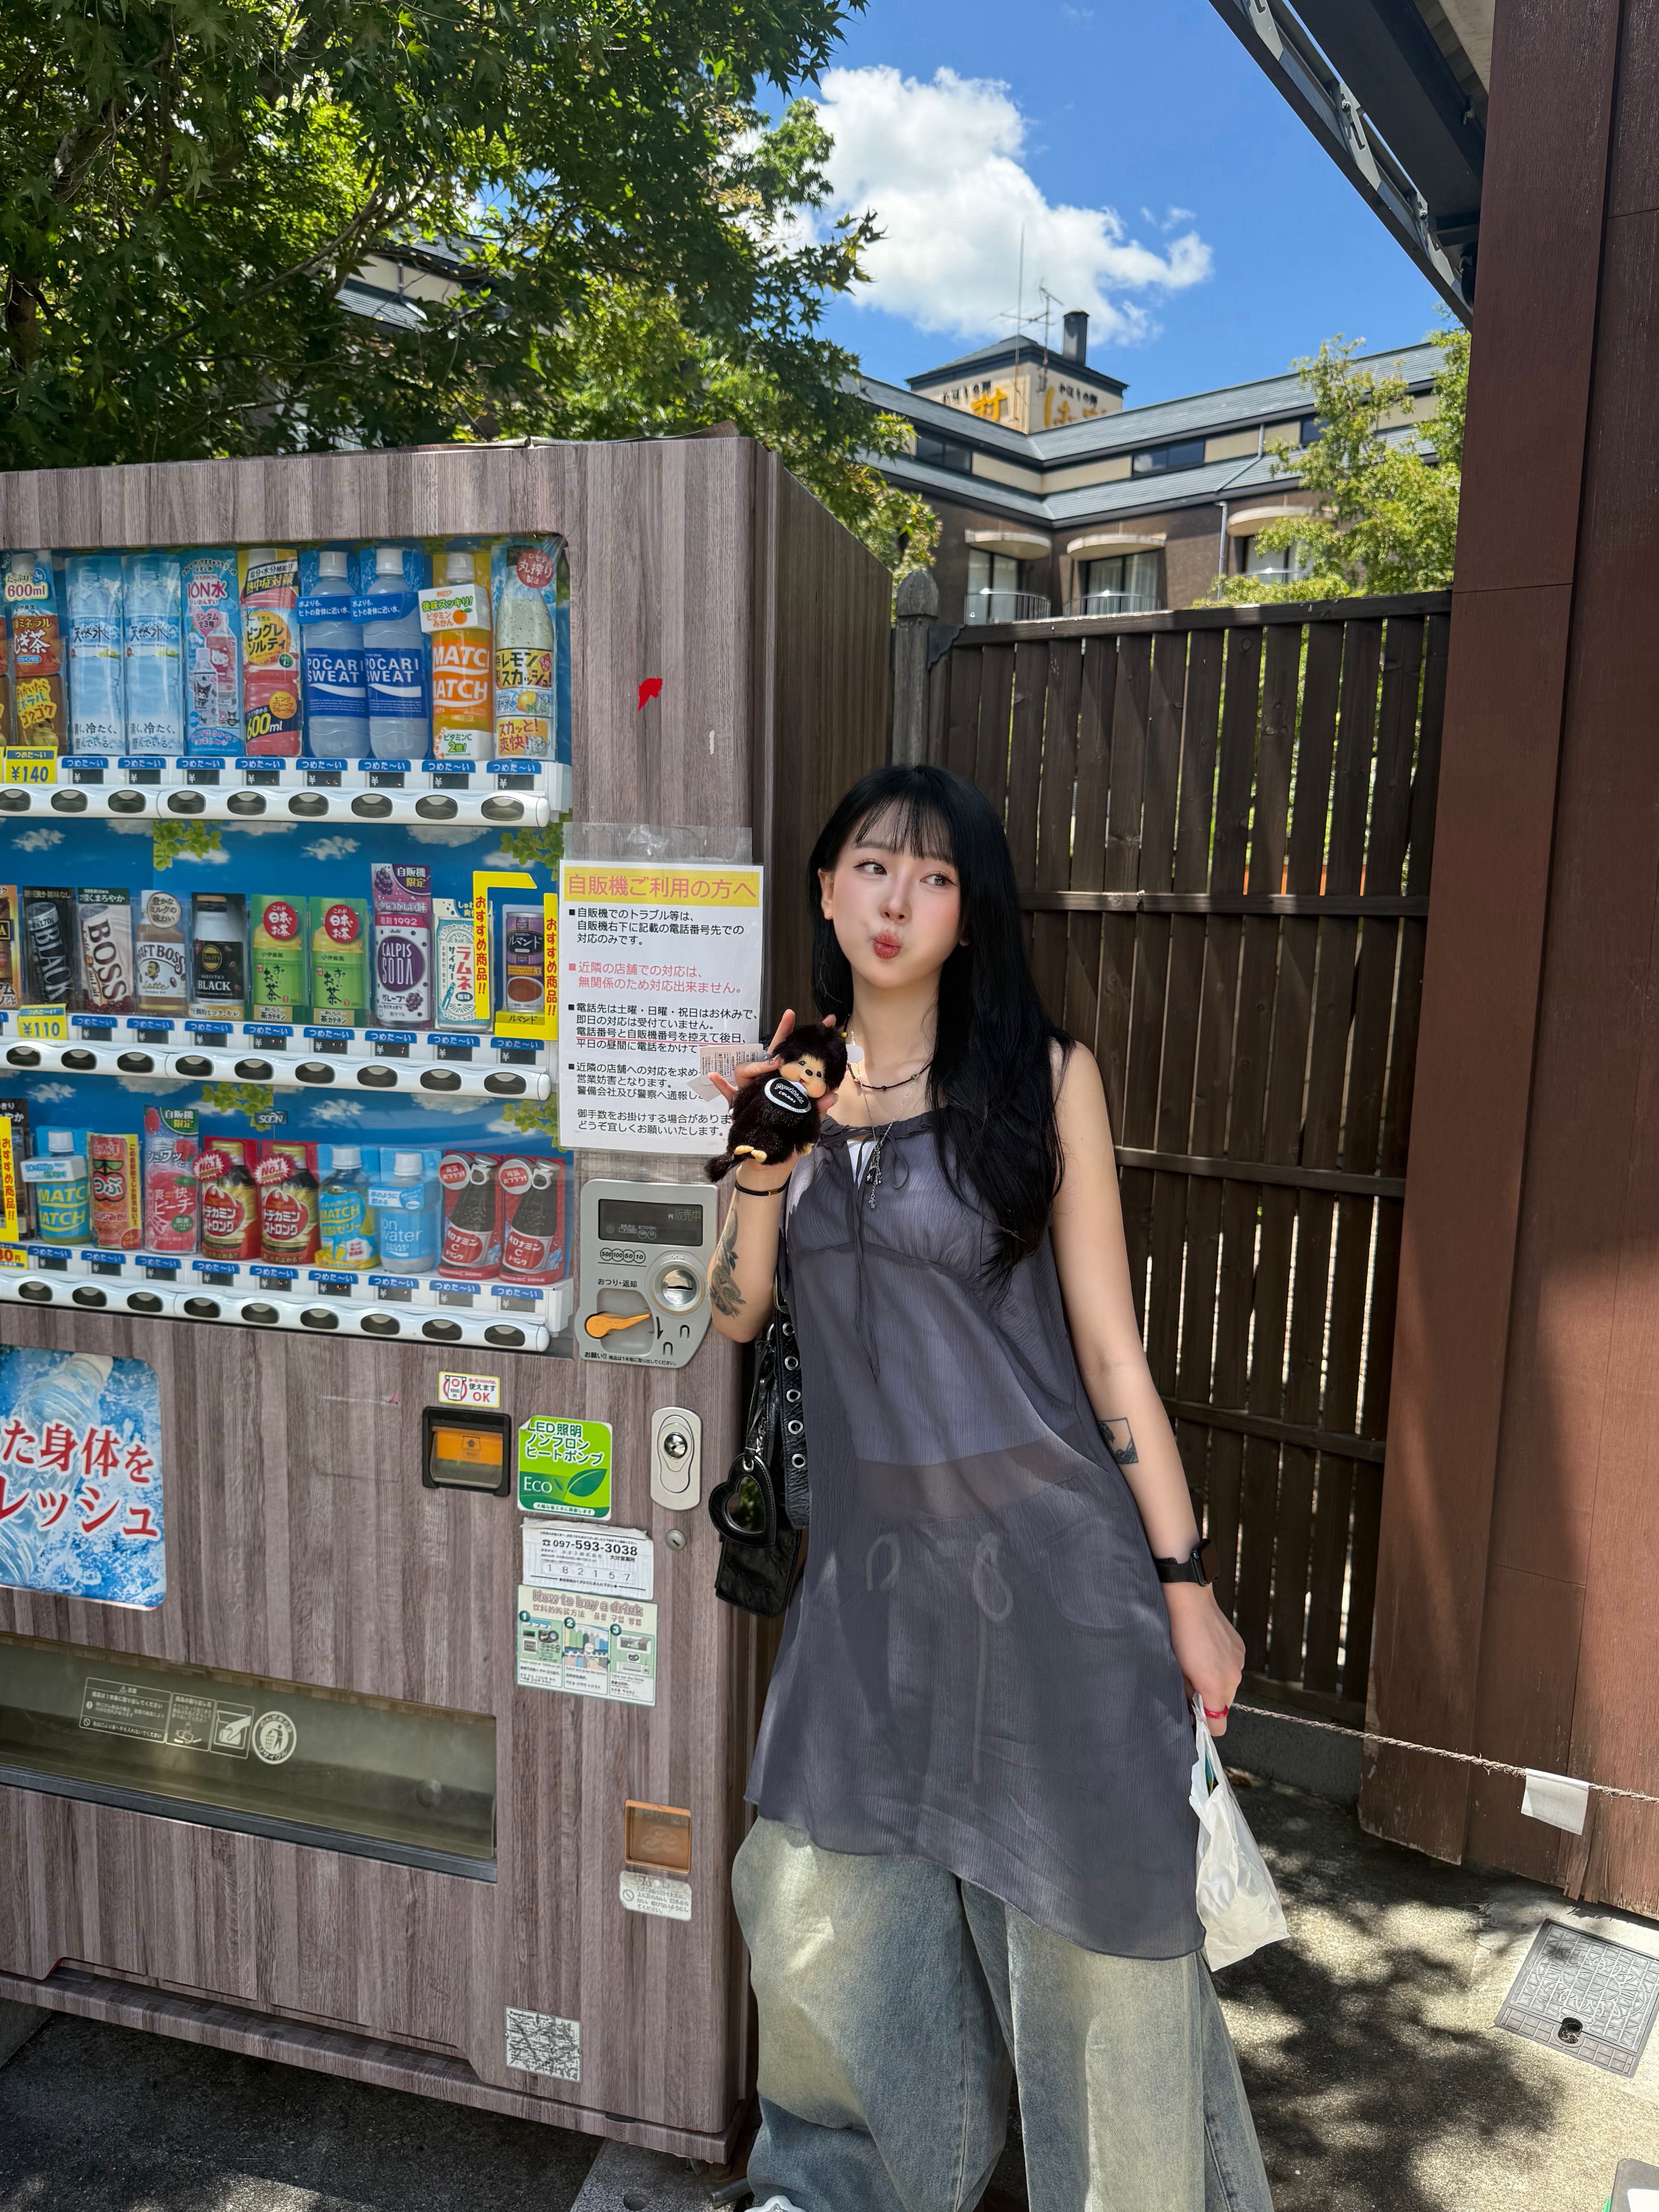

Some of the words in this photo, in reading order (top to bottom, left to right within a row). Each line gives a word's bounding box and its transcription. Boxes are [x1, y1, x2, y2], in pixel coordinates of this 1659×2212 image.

[8, 585, 45, 597] 600ml
[188, 581, 226, 598] ION水
[246, 575, 292, 594] 熱中症対策
[299, 607, 350, 616] ヒトの身体に近い水。
[353, 606, 400, 617] ヒトの身体に近い水。
[422, 596, 473, 612] 後味スッキリ!
[427, 612, 451, 621] ビタミン
[433, 619, 453, 628] みかん
[74, 626, 110, 643] 天然水
[130, 626, 169, 642] 天然水
[247, 623, 284, 642] ピングレ
[248, 638, 285, 655] ソルティ
[307, 658, 363, 671] POCARI
[366, 658, 418, 670] POCARI
[502, 652, 538, 668] レモン
[308, 670, 359, 683] SWEAT
[367, 671, 414, 682] SWEAT
[502, 669, 552, 687] スカッシュ!
[247, 713, 282, 740] 600ml
[499, 718, 539, 737] スカッと!
[448, 742, 466, 752] 2倍!
[500, 733, 528, 752] 爽快!
[12, 766, 48, 782] ¥140
[397, 867, 425, 877] 自販機
[406, 878, 425, 888] 限定
[569, 874, 756, 899] 自販機ご利用の方へ
[269, 912, 292, 925] 日本の
[330, 915, 353, 928] 日本の
[578, 907, 694, 921] 自販機でのトラブル等は、
[272, 924, 290, 936] お茶
[333, 927, 351, 940] お茶
[578, 920, 744, 935] 自販機右下に記載の電話番号先での
[476, 896, 487, 994] おすすめ商品!!
[509, 936, 542, 950] ルマンド
[577, 933, 643, 945] 対応のみです。
[382, 943, 411, 957] CALPIS
[88, 918, 127, 1000] BOSS
[382, 958, 413, 985] SODA
[457, 946, 472, 990] ラムネ
[547, 918, 557, 1016] おすすめ商品!!
[578, 961, 702, 978] 近隣の店舗での対応は、
[198, 980, 231, 991] BLACK
[578, 977, 742, 994] 無関係のため対応出来ません。
[261, 1011, 285, 1020] 茶カテキン
[577, 1003, 757, 1019] 電話先は土曜・日曜・祝日はお休みで、
[321, 1015, 346, 1024] 茶カテキン
[509, 1015, 538, 1025] ルマンド
[577, 1014, 714, 1030] 即日の対応は受付ていません。
[23, 1022, 59, 1036] ¥110
[577, 1027, 745, 1043] 電話番号と自販機番号を控えて後日、
[577, 1039, 700, 1054] 平日の昼間に電話をかけて
[577, 1062, 701, 1077] 近隣の店舗への対応を求め
[577, 1074, 671, 1088] 営業妨害となります。
[165, 1110, 193, 1119] 自販機
[174, 1119, 193, 1128] 限定
[579, 1120, 723, 1136] どうぞ宜しくお願いいたします。
[199, 1157, 218, 1171] No.1
[262, 1160, 282, 1175] No.1
[2, 1138, 15, 1220] おすすめ商品!!
[94, 1178, 122, 1195] つぶ
[155, 1198, 193, 1215] ピーチ
[321, 1204, 359, 1219] MATCH
[674, 1209, 700, 1222] 販売中
[598, 1278, 637, 1288] おつり・返却
[469, 1383, 496, 1391] 使えます
[473, 1392, 490, 1402] OK
[527, 1422, 581, 1437] LED照明
[527, 1434, 589, 1450] ノンフロン
[4, 1420, 154, 1483] た身体を
[527, 1446, 603, 1464] ヒートポンプ
[553, 1540, 638, 1556] 097-593-3038
[533, 1589, 560, 1604] How
[561, 1595, 574, 1605] to
[576, 1595, 599, 1611] buy
[600, 1602, 609, 1611] a
[610, 1601, 644, 1616] drink
